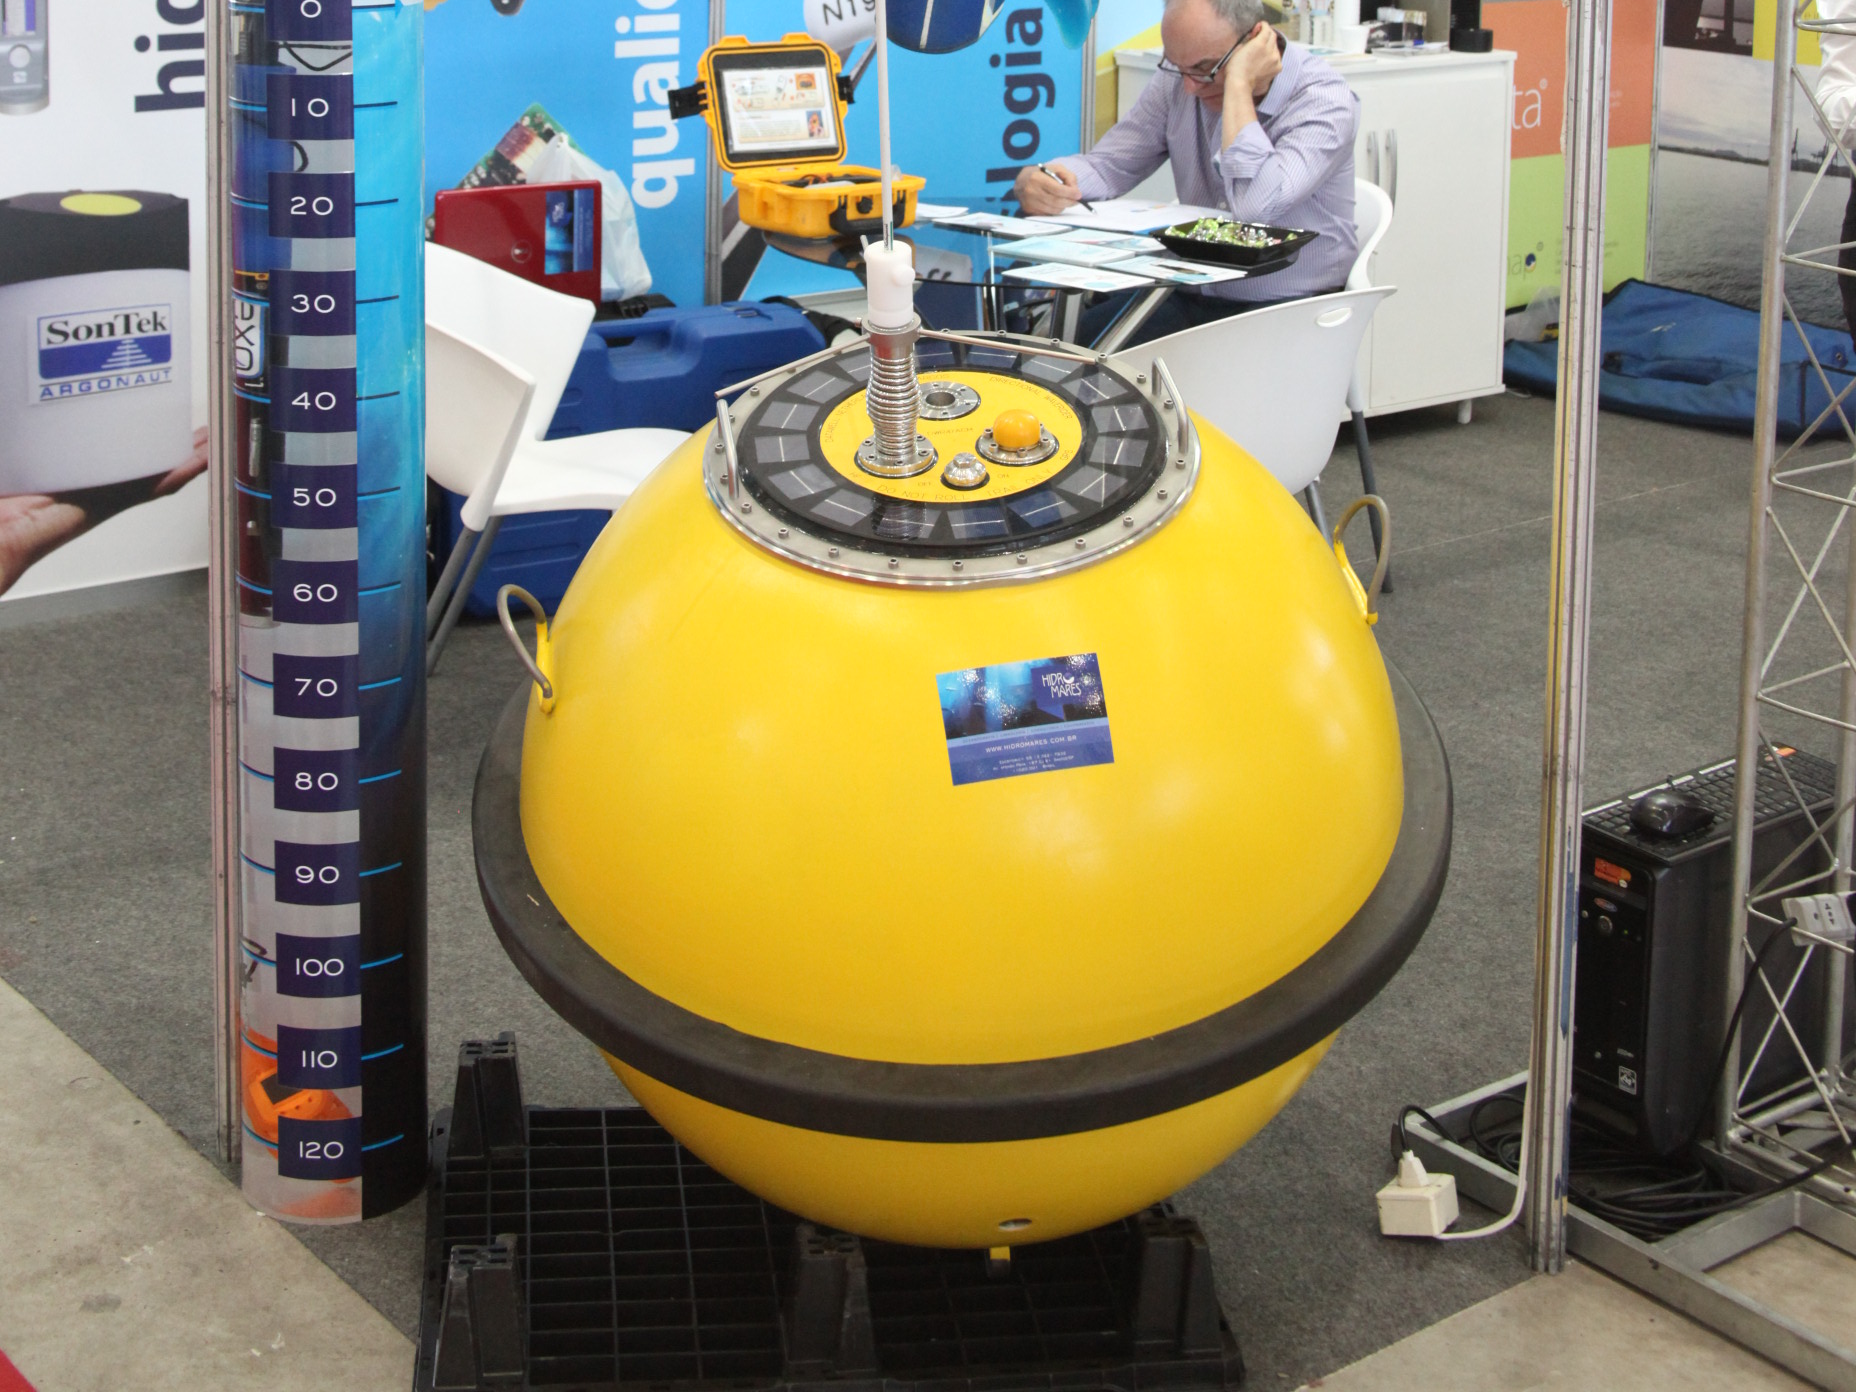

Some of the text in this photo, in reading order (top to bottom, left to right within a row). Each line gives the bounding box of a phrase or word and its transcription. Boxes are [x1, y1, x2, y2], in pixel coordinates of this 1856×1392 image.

[291, 97, 329, 118] 10
[985, 6, 1057, 202] logia
[290, 196, 334, 216] 20
[291, 294, 336, 314] 30
[46, 311, 168, 346] SonTek
[40, 370, 170, 398] ARGONAUT
[291, 391, 336, 411] 40
[293, 487, 337, 507] 50
[876, 484, 892, 494] DO
[901, 490, 926, 500] NOT
[934, 493, 970, 501] ROLL
[293, 583, 338, 603] 60
[294, 678, 338, 697] 70
[1051, 682, 1082, 699] MARES
[295, 772, 339, 791] 80
[295, 865, 340, 884] 90
[295, 958, 344, 977] 100
[301, 1050, 338, 1069] 110
[299, 1141, 344, 1159] 120
